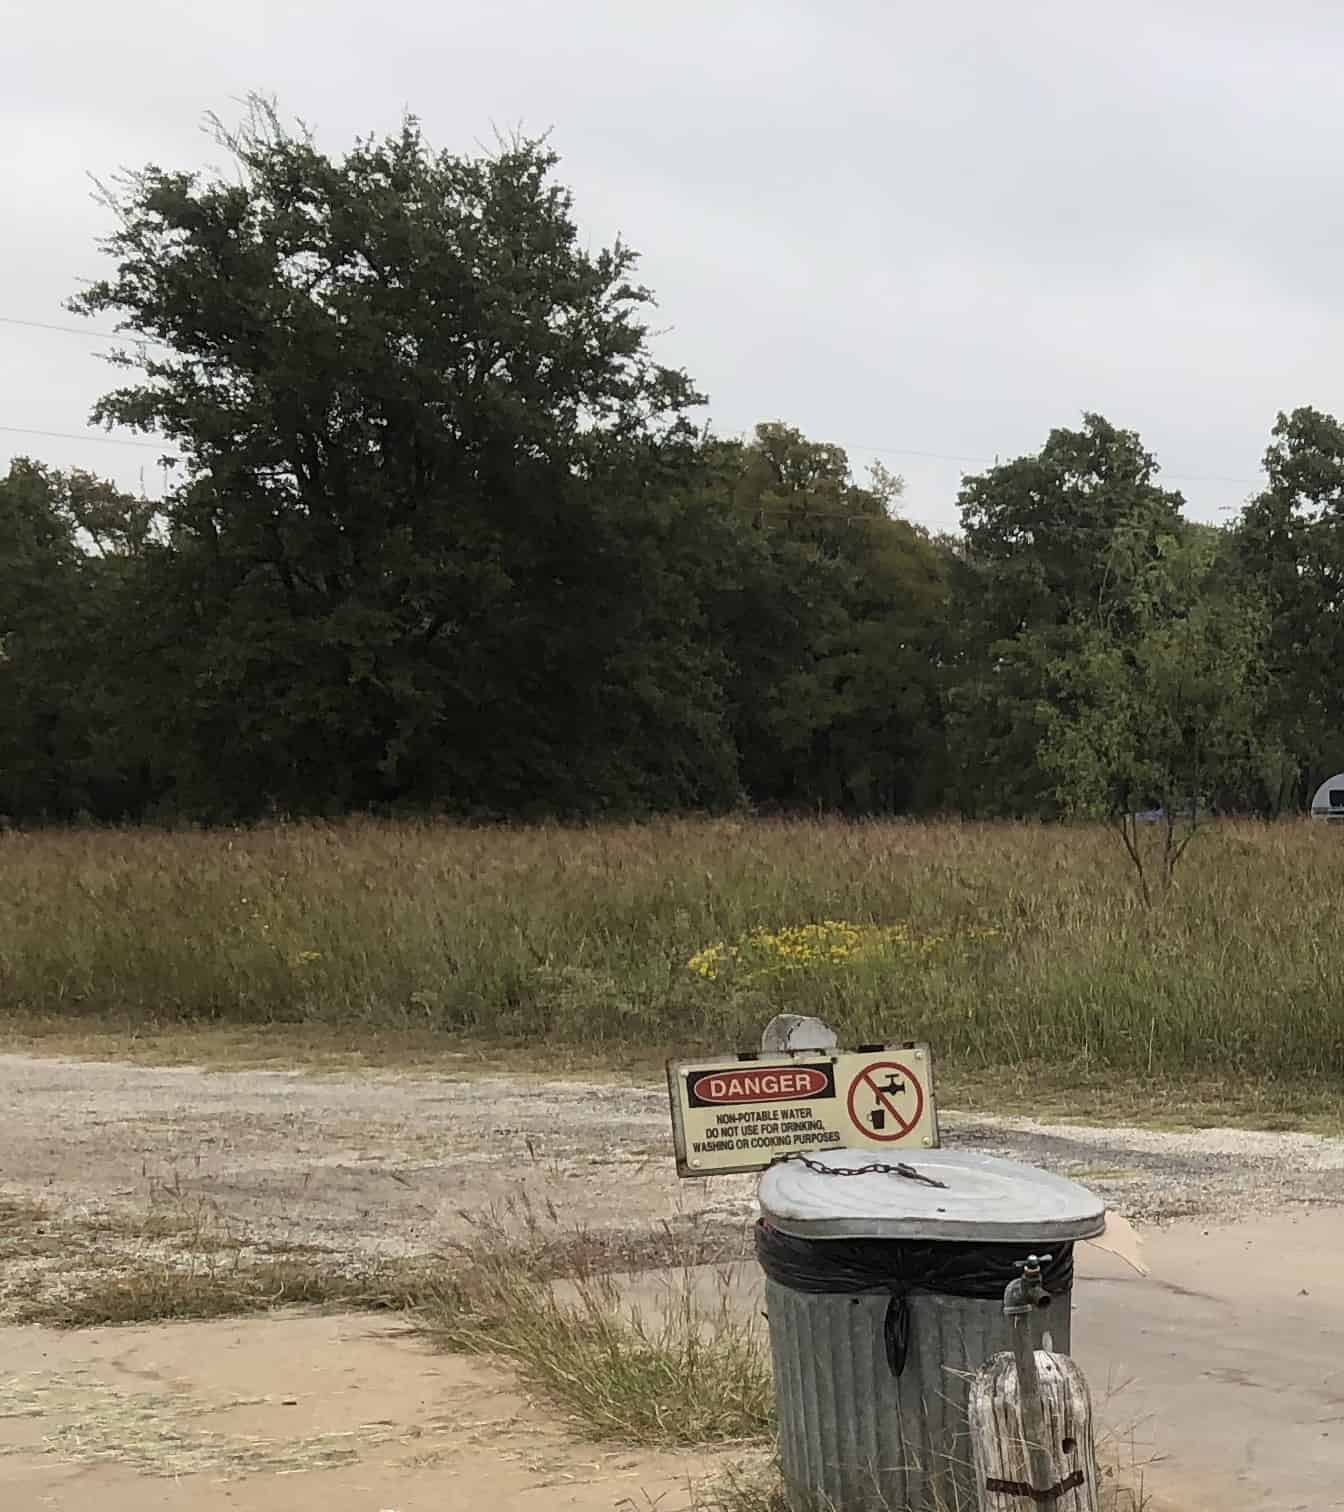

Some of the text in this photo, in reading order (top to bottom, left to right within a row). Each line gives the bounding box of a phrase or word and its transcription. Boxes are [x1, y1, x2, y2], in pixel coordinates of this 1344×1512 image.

[710, 1073, 812, 1098] DANGER
[716, 1107, 813, 1125] NON-POTABLE WATER
[705, 1120, 825, 1139] DO NOT USE FOR DRINKING,
[693, 1131, 841, 1153] WASHING OR COOKING PURPOSES
